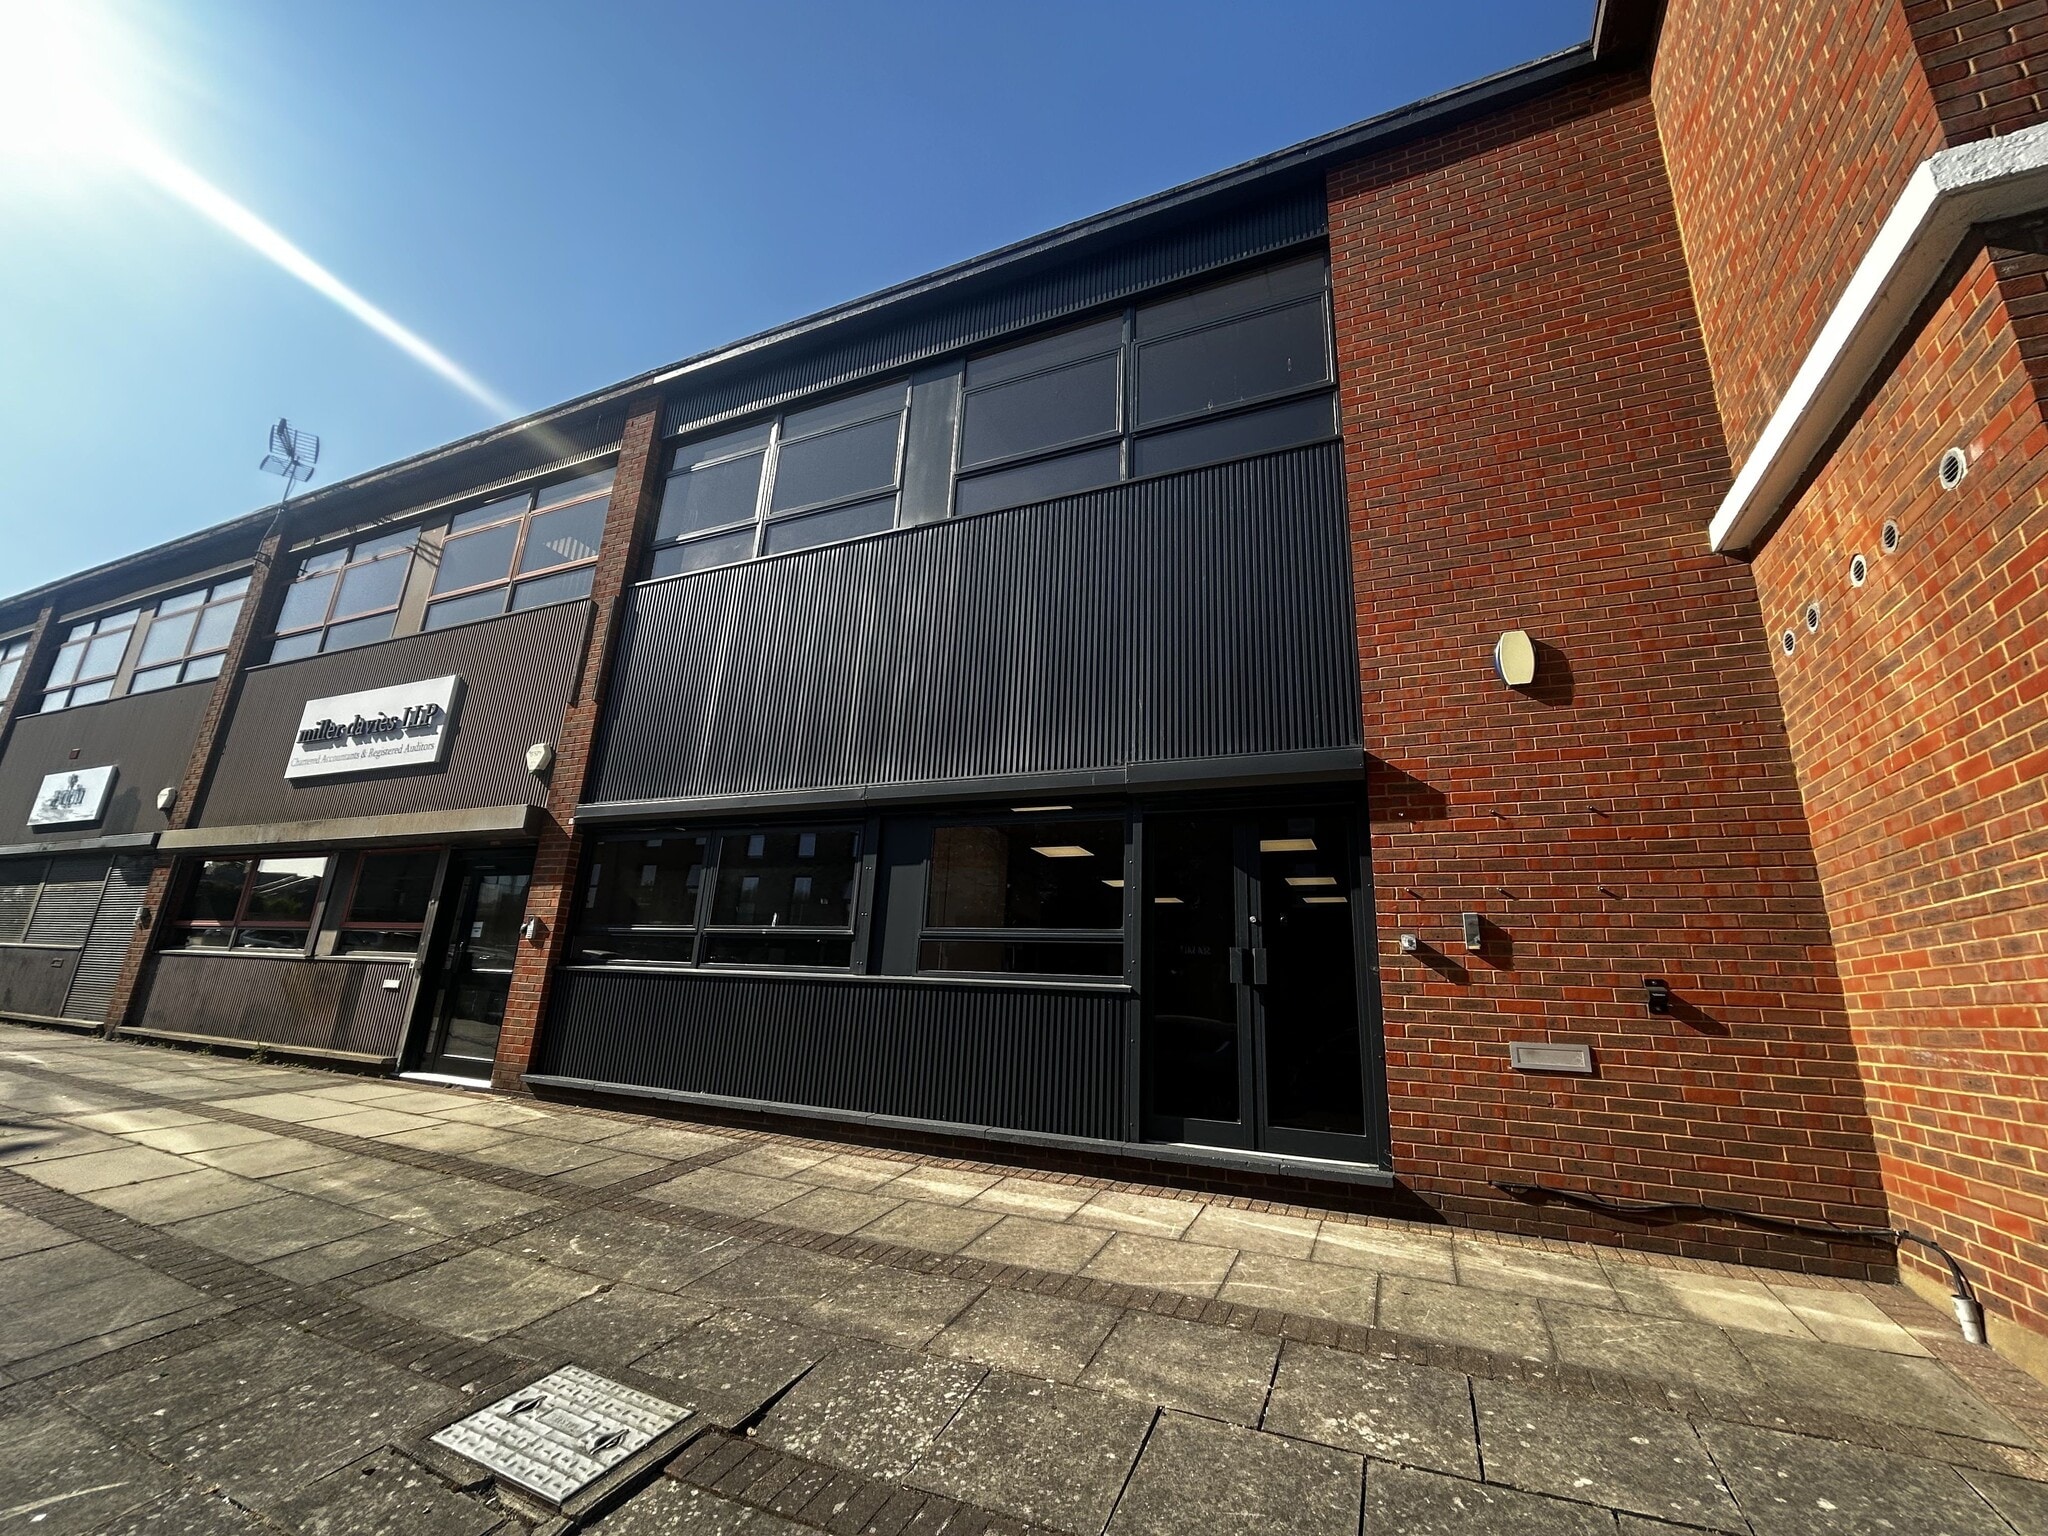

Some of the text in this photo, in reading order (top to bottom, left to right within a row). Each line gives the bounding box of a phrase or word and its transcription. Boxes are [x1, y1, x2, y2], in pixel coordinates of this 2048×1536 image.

[295, 718, 346, 744] miller
[346, 711, 399, 735] davies
[291, 741, 434, 767] Chartered Accountants & Registered Auditors
